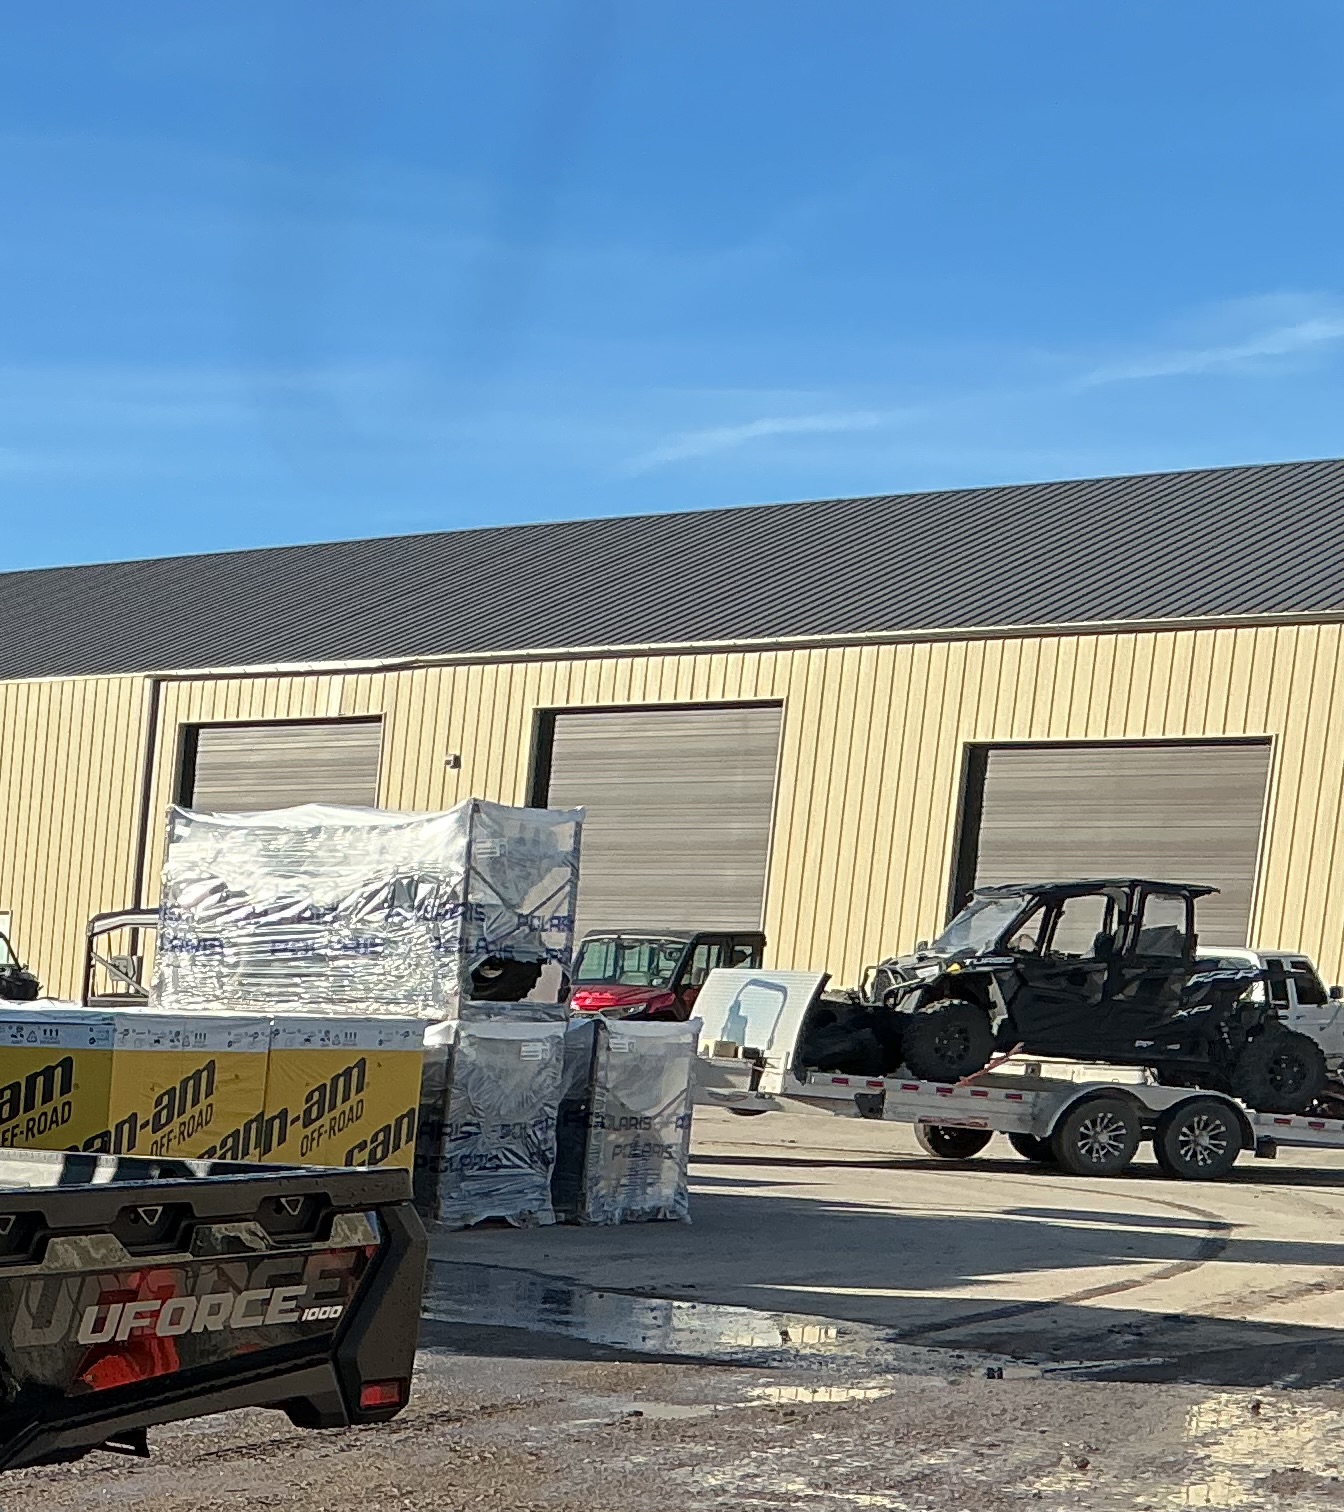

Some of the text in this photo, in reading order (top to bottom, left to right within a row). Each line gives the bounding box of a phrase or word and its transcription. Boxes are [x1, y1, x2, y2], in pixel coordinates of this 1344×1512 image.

[299, 1098, 365, 1158] OFF-ROAD
[77, 1285, 344, 1345] UFORCE 1000
